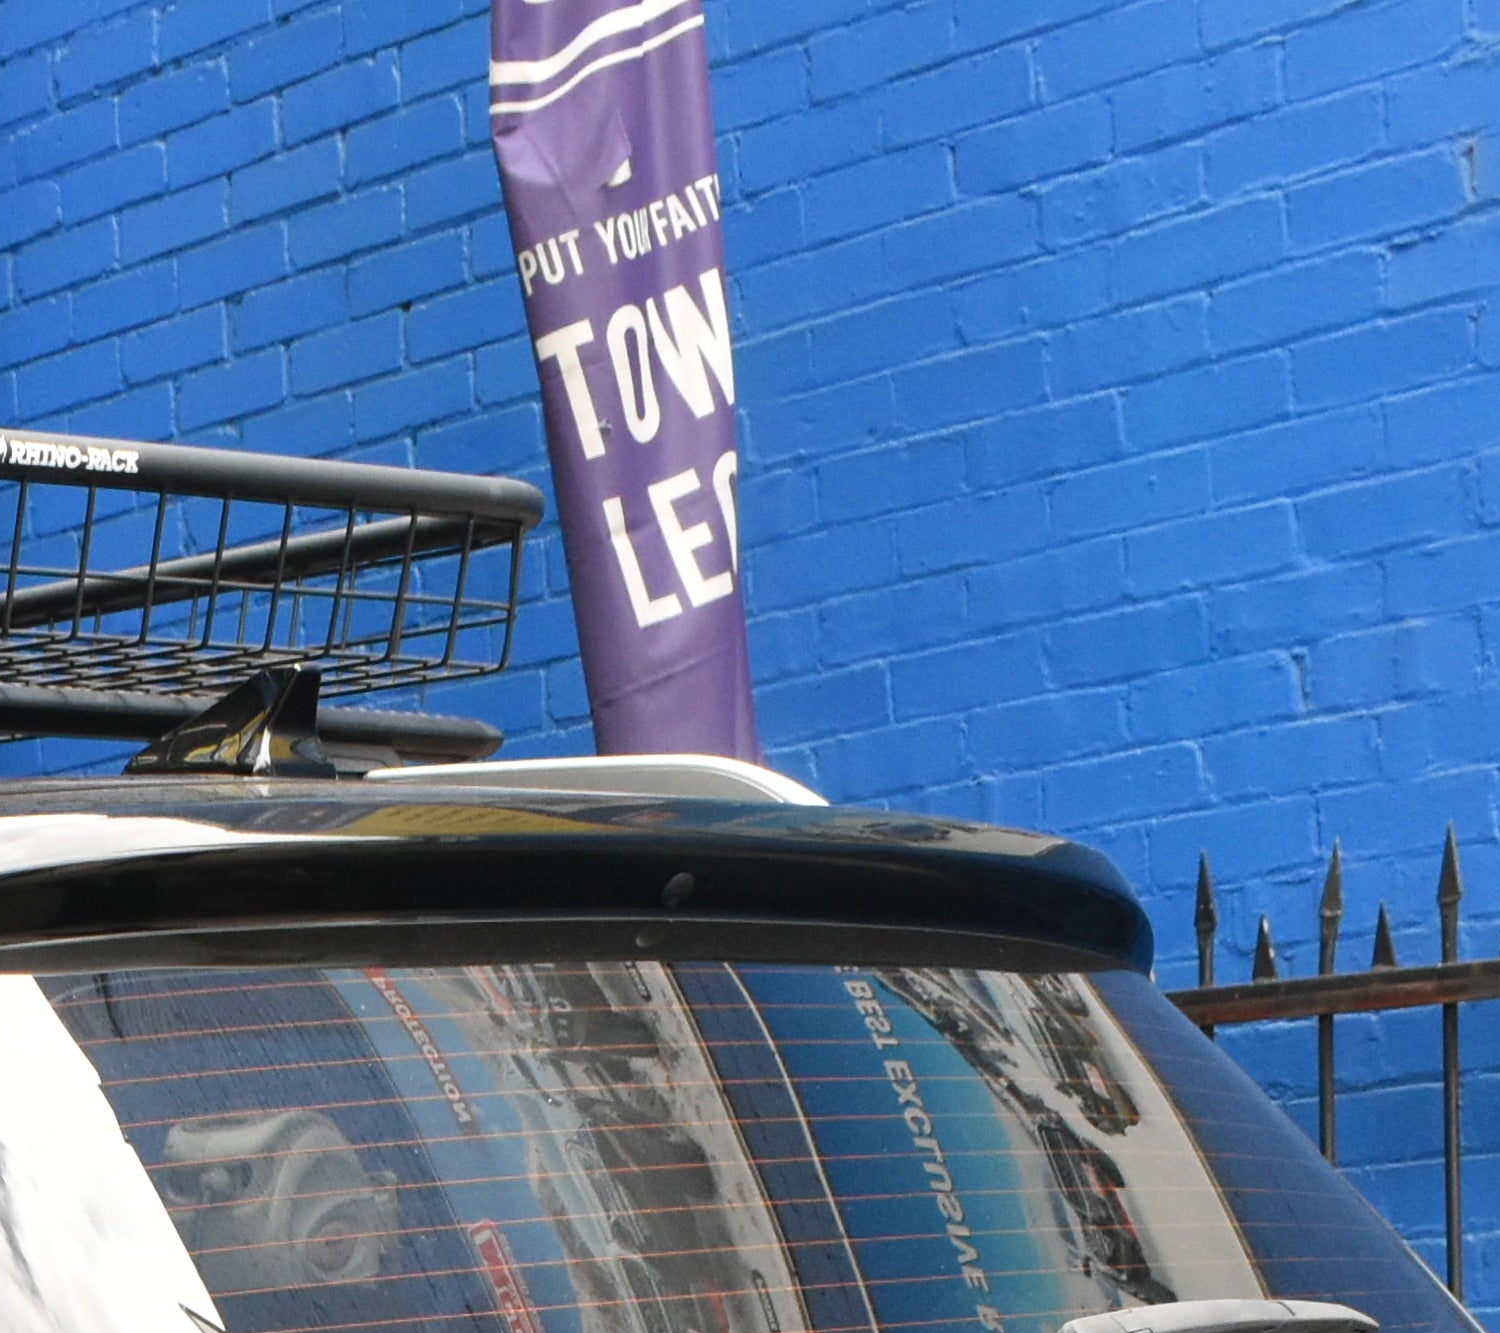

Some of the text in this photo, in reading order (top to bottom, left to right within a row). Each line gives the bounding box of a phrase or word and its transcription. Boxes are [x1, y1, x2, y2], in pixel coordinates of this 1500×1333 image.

[518, 229, 583, 296] PUT
[535, 268, 735, 460] TOW
[8, 440, 139, 473] RHINO-RACK
